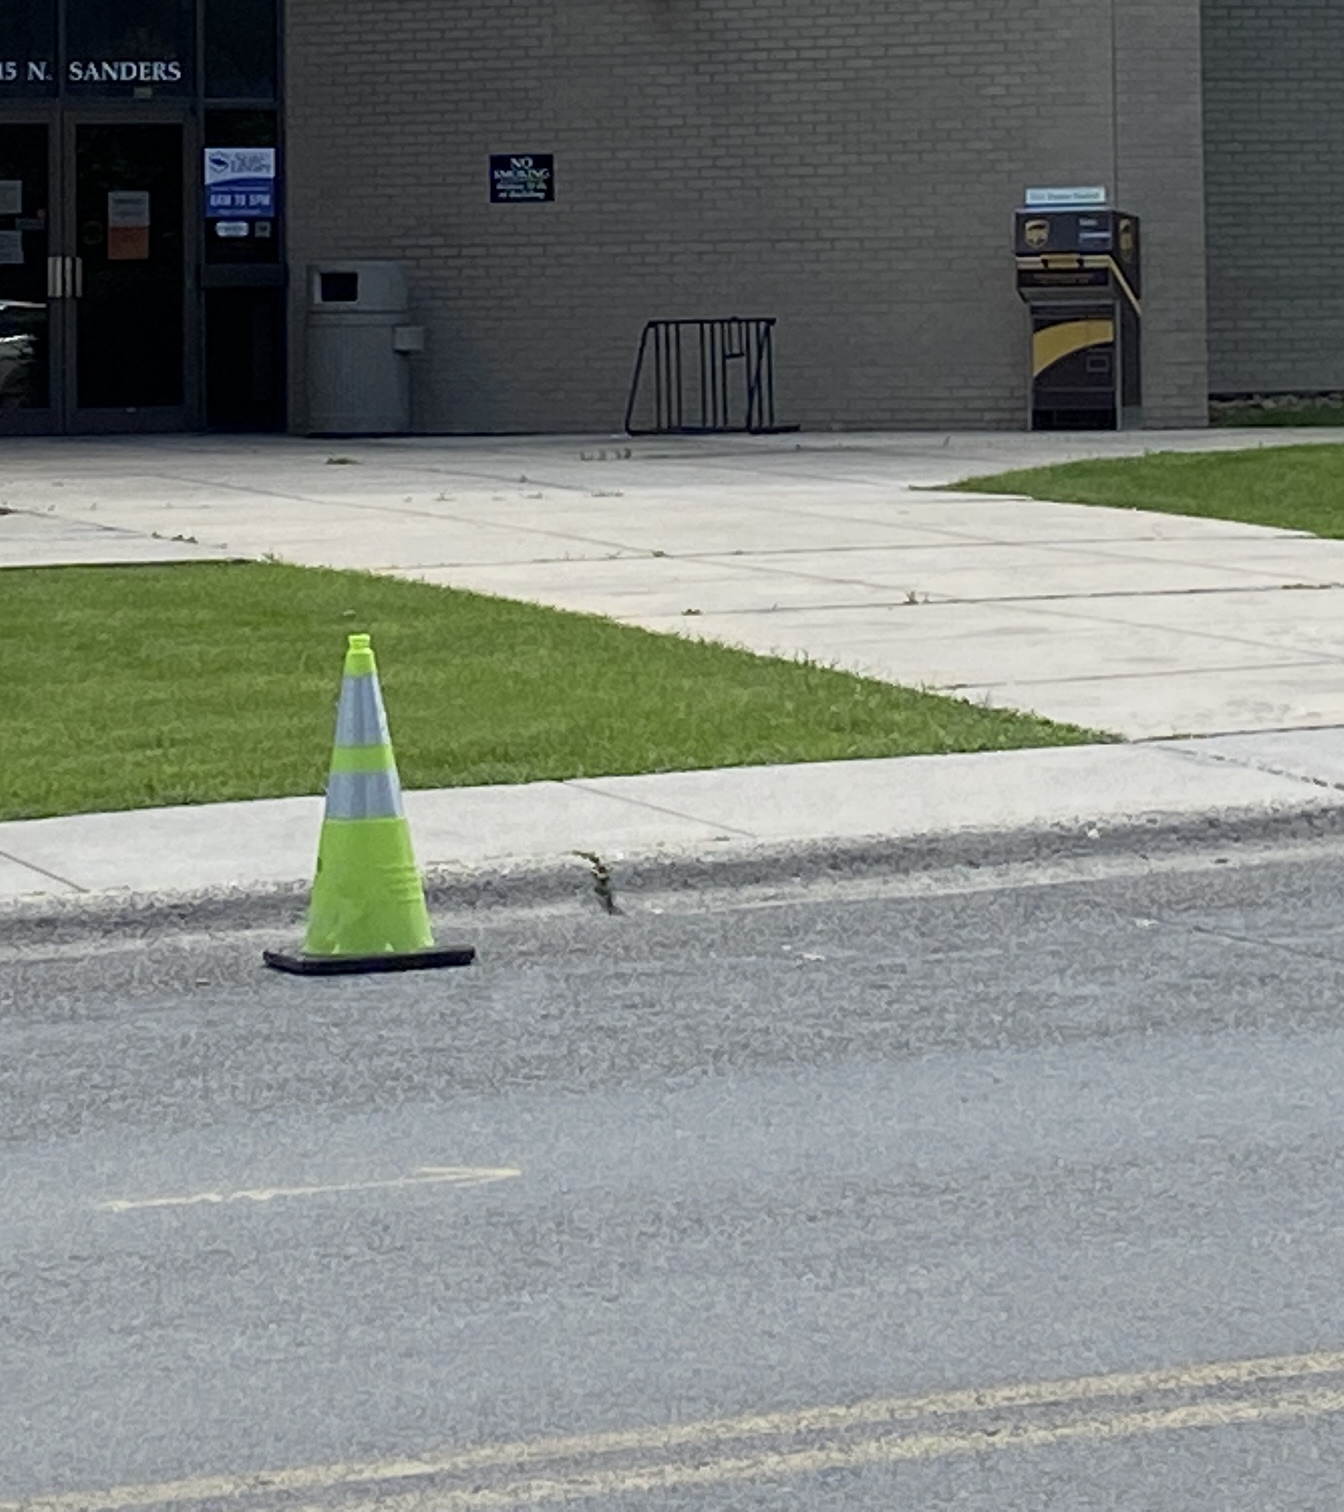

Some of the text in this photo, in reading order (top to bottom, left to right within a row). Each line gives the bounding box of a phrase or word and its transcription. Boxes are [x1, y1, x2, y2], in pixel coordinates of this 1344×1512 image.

[27, 61, 54, 81] N.
[69, 61, 182, 81] SANDERS
[510, 157, 534, 169] NO
[494, 168, 551, 180] SMOKING
